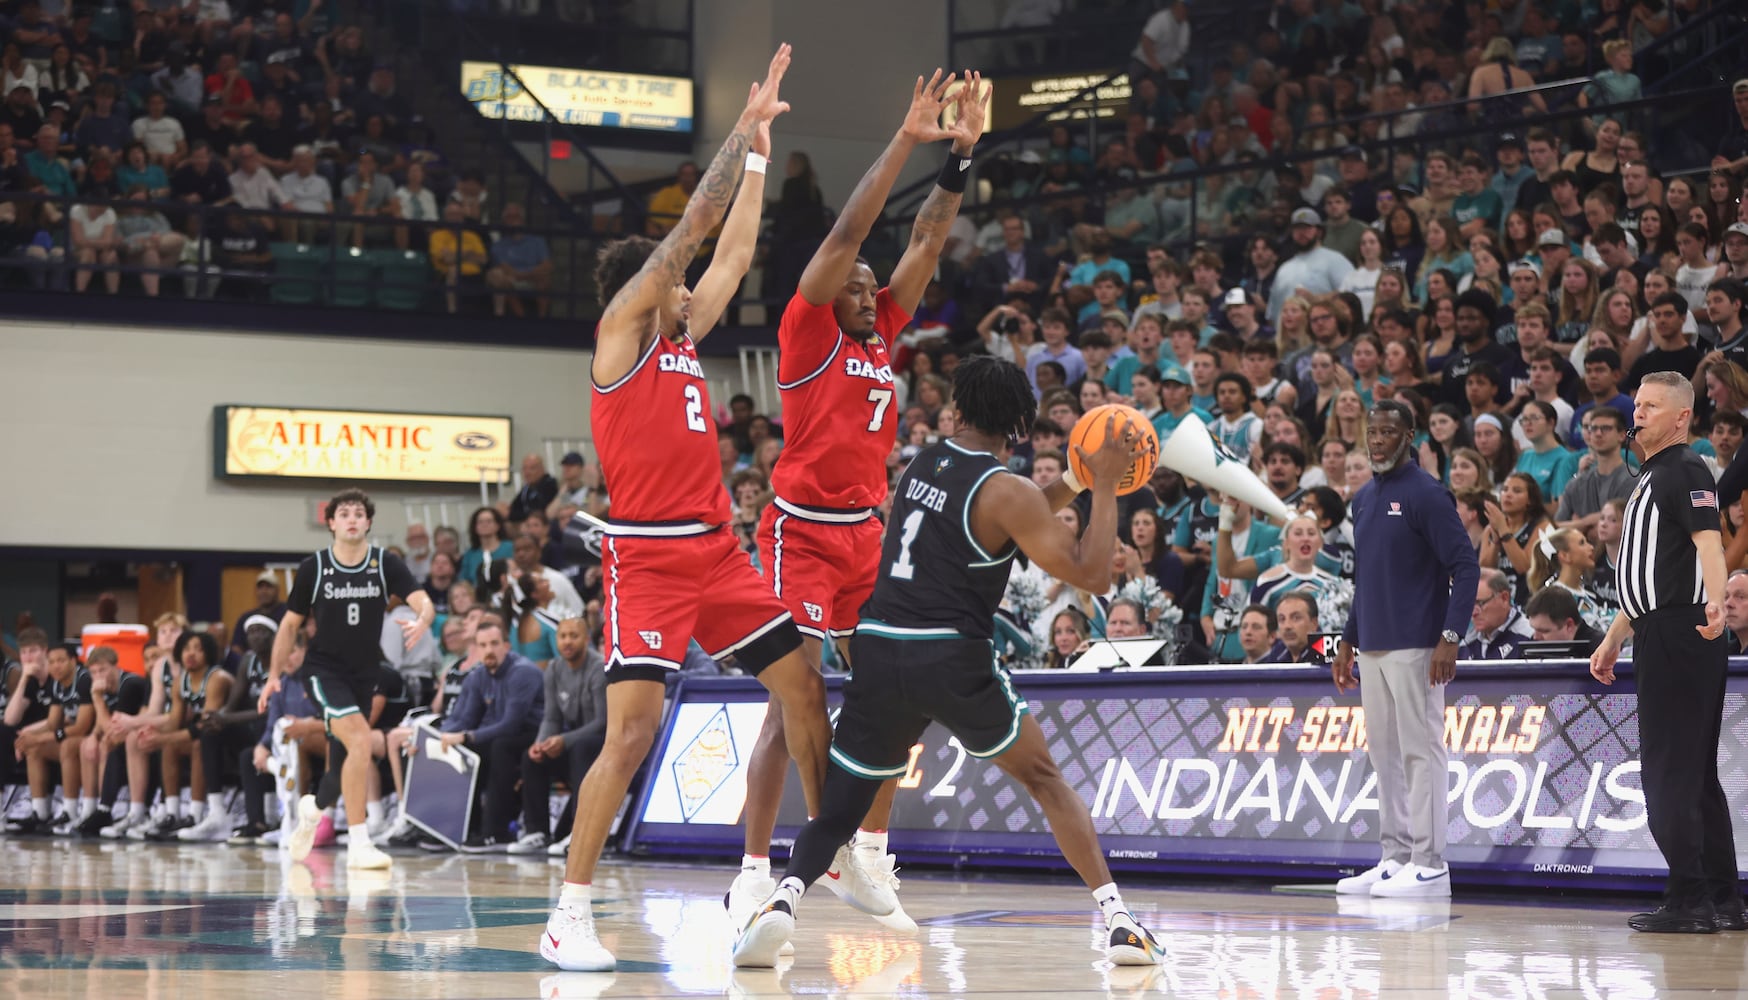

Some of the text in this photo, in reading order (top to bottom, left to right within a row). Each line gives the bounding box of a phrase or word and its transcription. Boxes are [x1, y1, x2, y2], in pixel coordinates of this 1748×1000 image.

[547, 72, 678, 97] BLACK'S TIRE
[684, 384, 707, 433] 2
[867, 388, 893, 432] 7
[268, 420, 433, 452] ATLANTIC
[291, 450, 415, 472] MARINE
[905, 478, 948, 512] DURR
[890, 509, 925, 580] 1
[324, 580, 381, 600] Seahawks
[347, 602, 360, 626] 8
[1217, 706, 1546, 754] NIT SEMNALS
[1109, 849, 1158, 860] DAKTRONICS
[1533, 863, 1594, 874] DAKTRONICS
